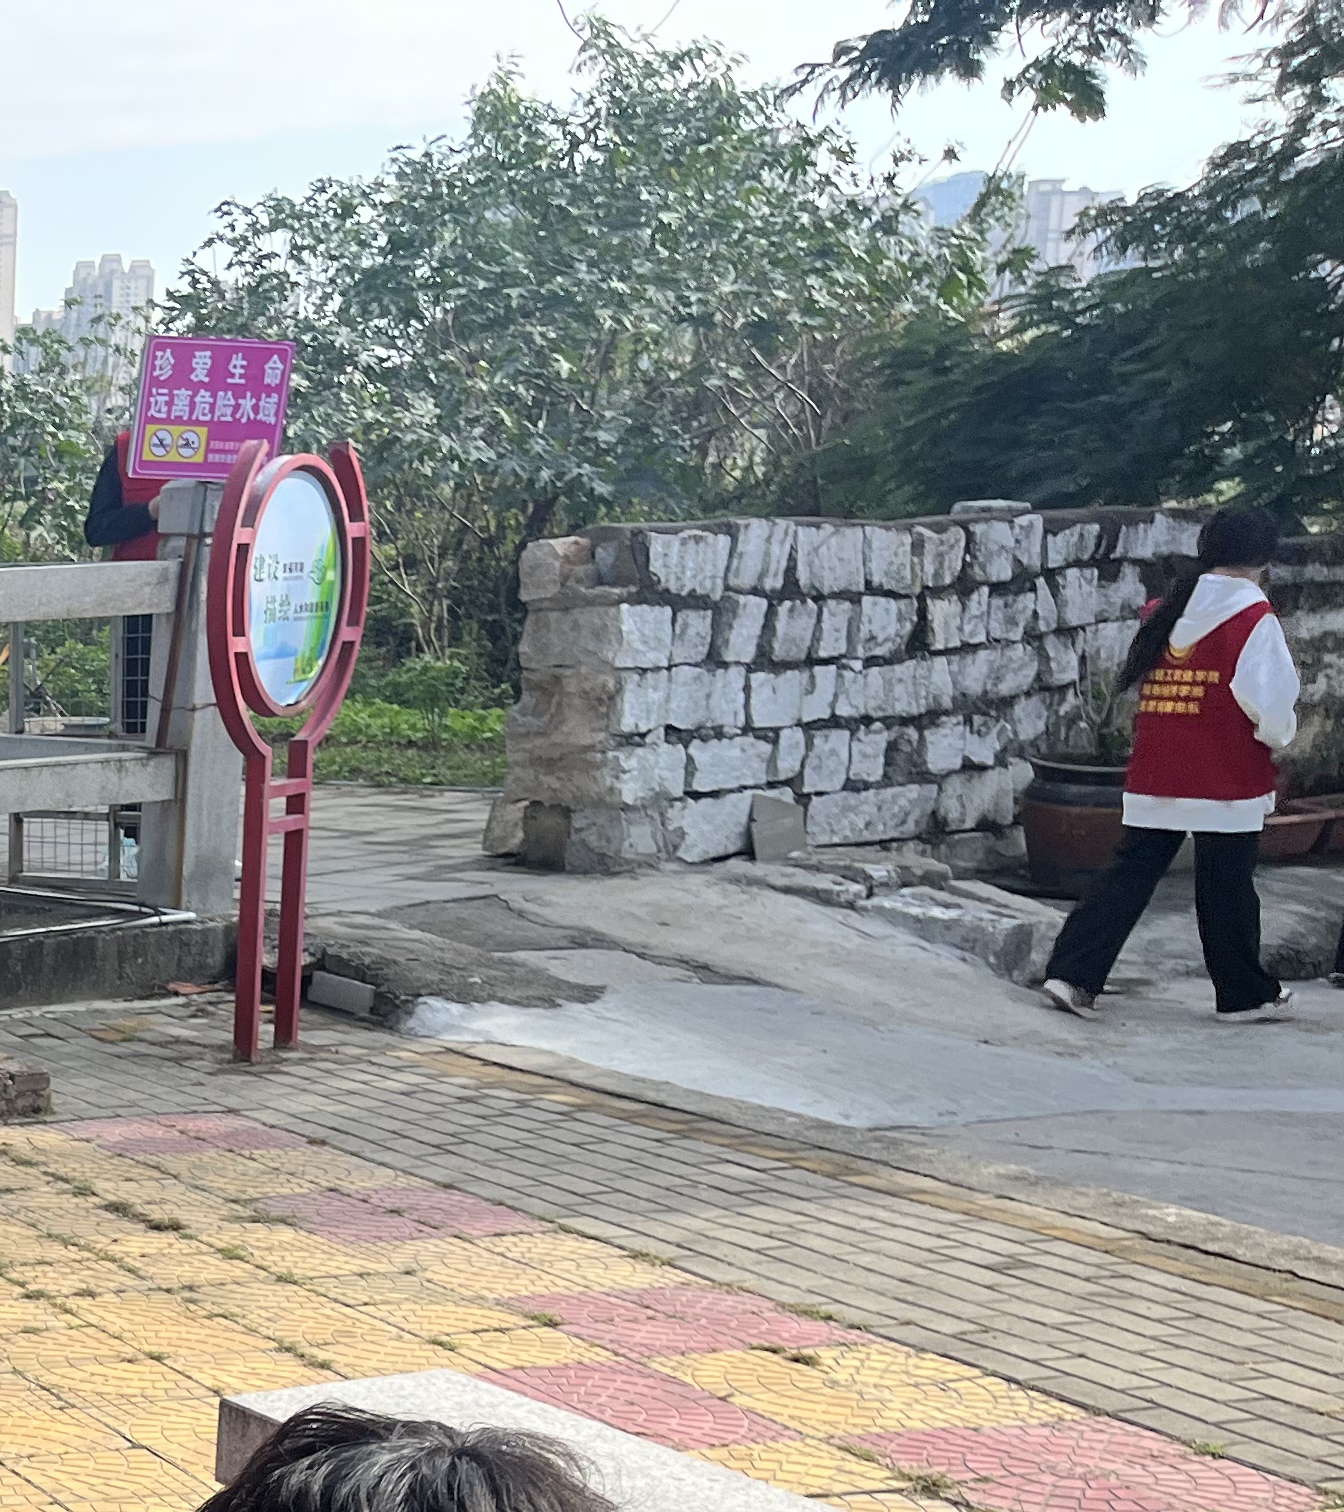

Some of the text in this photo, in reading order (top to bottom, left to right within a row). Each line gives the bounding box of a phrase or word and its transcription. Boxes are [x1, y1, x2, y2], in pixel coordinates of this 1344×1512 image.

[153, 348, 284, 387] 珍爱生命
[148, 388, 279, 425] 远离危险水域
